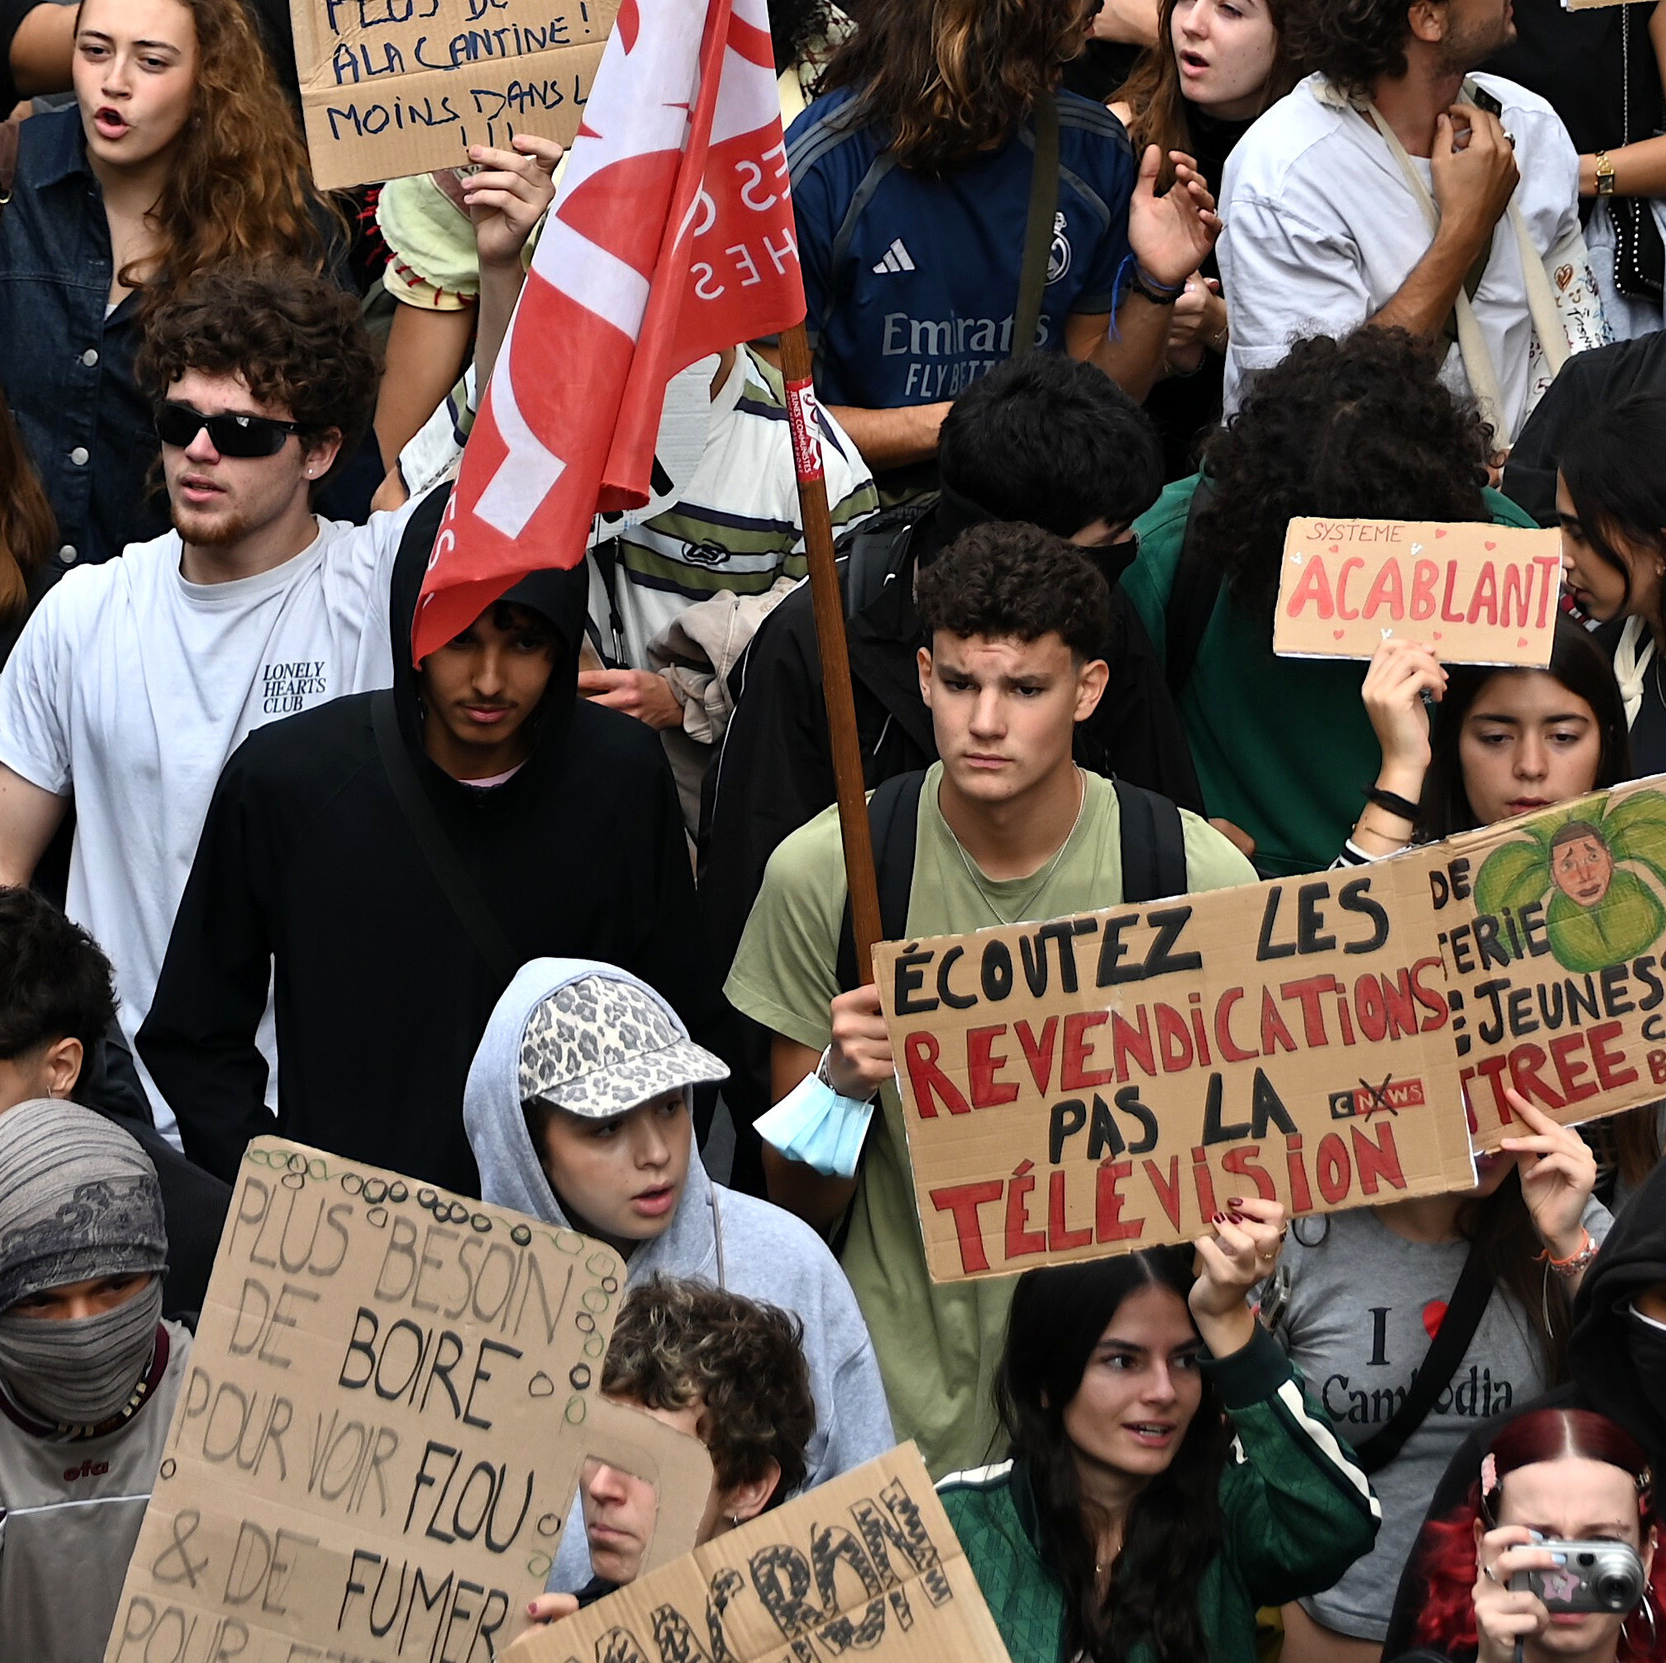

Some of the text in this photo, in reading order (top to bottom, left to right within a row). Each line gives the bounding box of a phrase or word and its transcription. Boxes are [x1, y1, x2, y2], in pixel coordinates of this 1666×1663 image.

[414, 16, 571, 71] CANTINE
[327, 80, 563, 140] MOINS DANS
[905, 363, 948, 397] FLY
[1286, 553, 1559, 629] ACABLANT
[263, 662, 326, 713] LONELY HEARTS CLUB
[1429, 858, 1472, 909] DE
[894, 877, 1390, 1016] ÉCOUTEZ LES
[904, 955, 1448, 1120] REVENDICATIONS
[1048, 1067, 1300, 1165] PAS LA
[228, 1175, 574, 1344] PLUS BESOIN
[228, 1277, 524, 1430] DE BOIRE
[1366, 1307, 1392, 1367] I
[174, 1366, 534, 1554] POUR VOIR FLOU
[223, 1518, 510, 1663] DE FUMER
